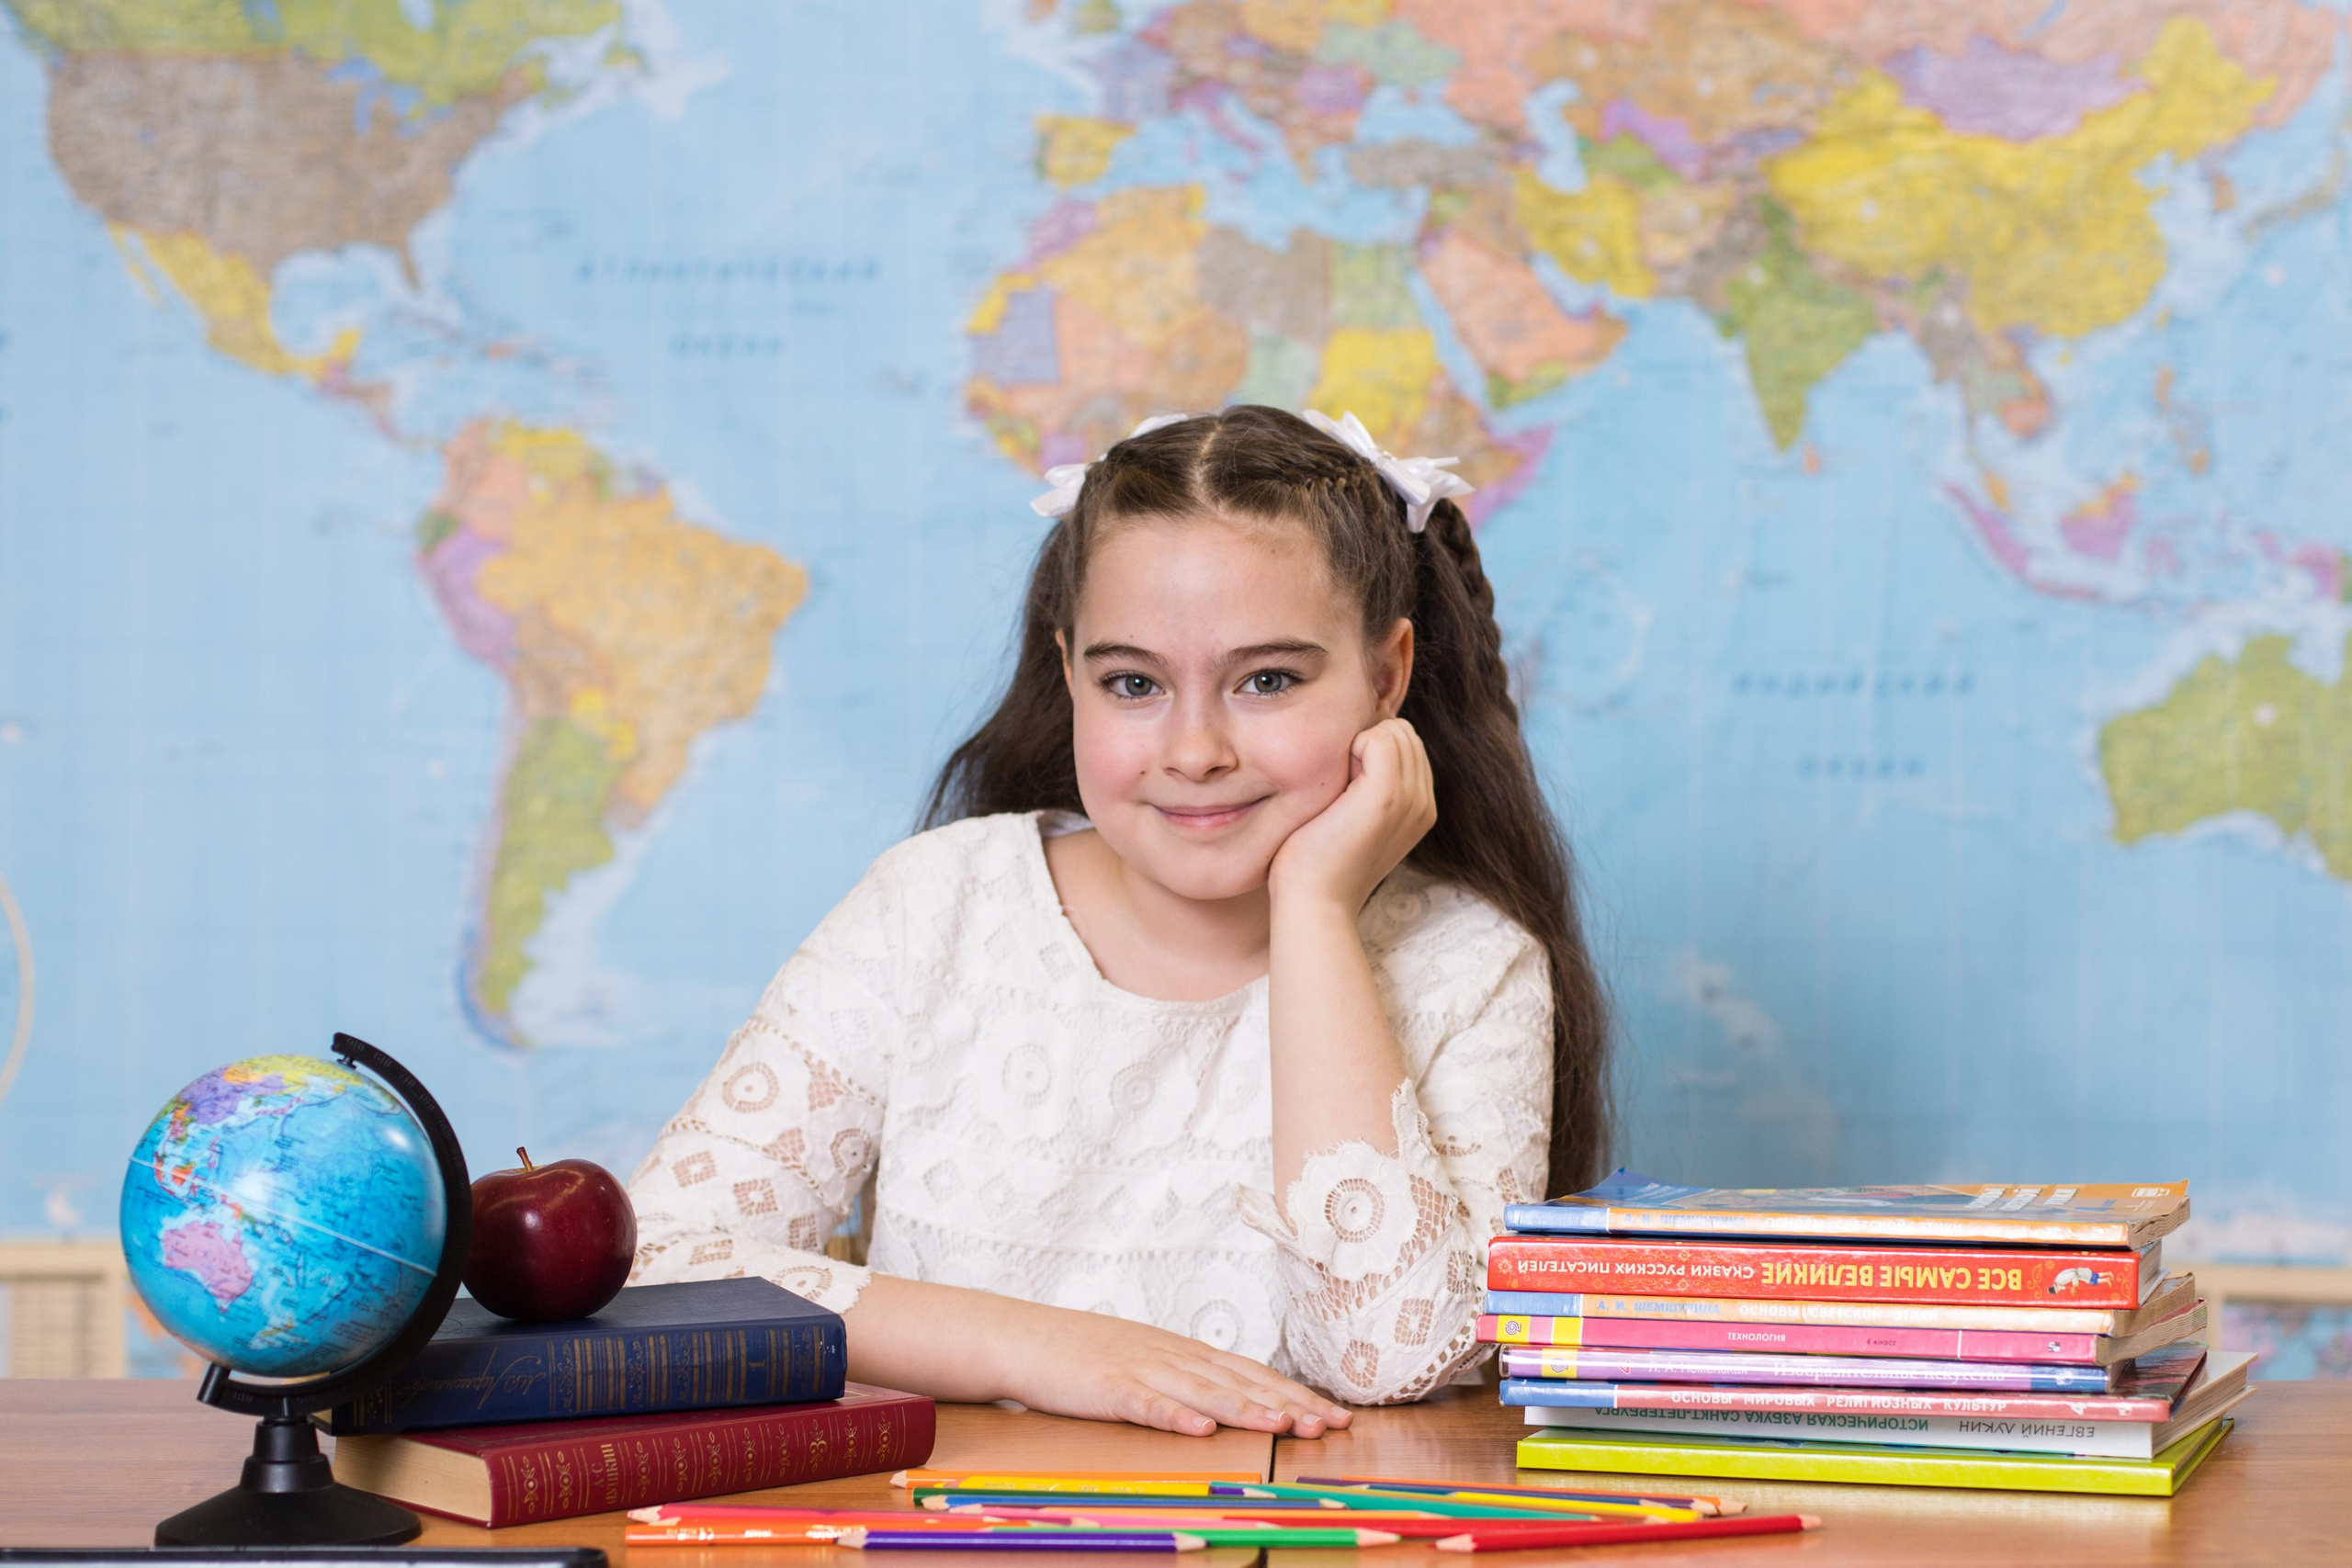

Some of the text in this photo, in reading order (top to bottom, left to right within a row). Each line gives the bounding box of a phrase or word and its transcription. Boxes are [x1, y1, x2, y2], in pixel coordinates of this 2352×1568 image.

[1765, 1217, 1826, 1232] ОСНОВЫ
[1518, 1258, 1754, 1280] СКАЗКИ РУССКИХ ПИСАТЕЛЕЙ
[1760, 1262, 2022, 1291] ВСЕ САМЫЕ ВЕЛИКИЕ
[1739, 1304, 1800, 1318] ОСНОВЫ
[1807, 1305, 1882, 1321] СВЕТСКОЙ
[1892, 1308, 1939, 1321] ЭТИКИ
[1727, 1331, 1786, 1343] ТЕХНОЛОГИЯ
[1671, 1392, 2007, 1413] ОСНОВЫ МИРОВЫХ РЕЛИГИОЗНЫХ КУЛЬТУР
[1746, 1412, 1802, 1425] АЗБУКА
[1806, 1415, 1929, 1431] ИСТОРИЧЕСКАЯ
[1959, 1420, 2096, 1438] ЕВГЕНИЙ ЛУКИН
